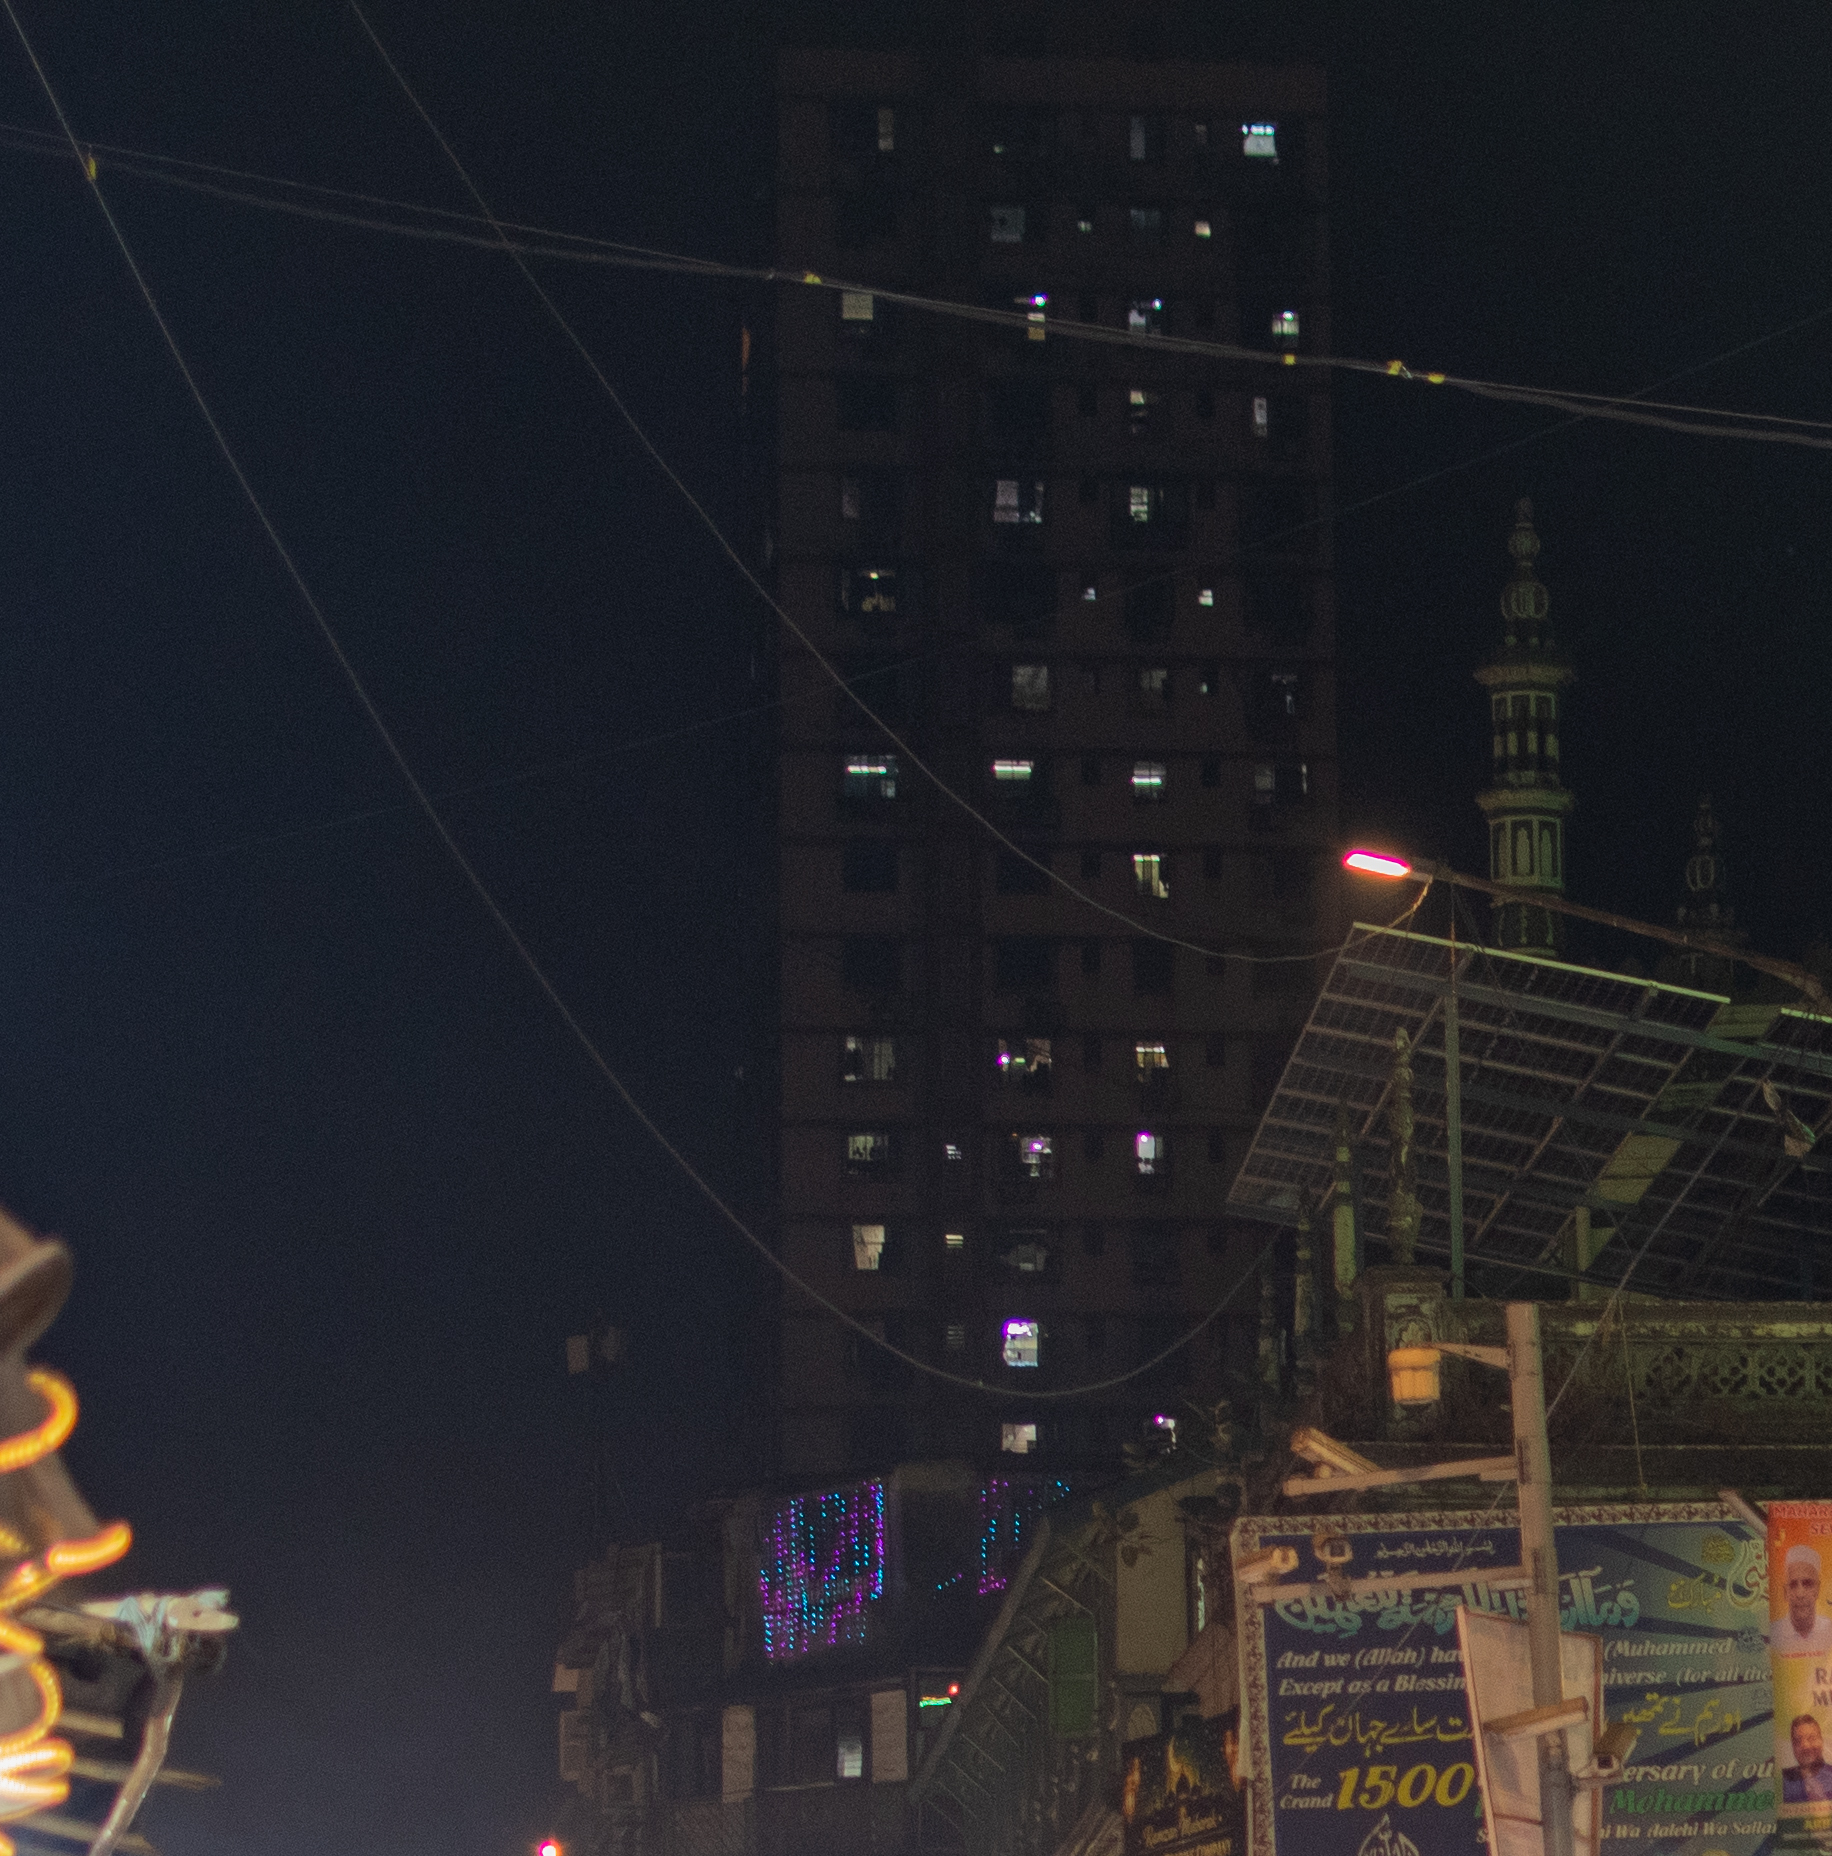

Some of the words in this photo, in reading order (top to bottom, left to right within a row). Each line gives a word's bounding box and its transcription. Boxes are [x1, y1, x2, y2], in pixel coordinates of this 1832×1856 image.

[1276, 1649, 1318, 1669] And
[1323, 1653, 1351, 1667] we
[1278, 1674, 1345, 1698] Except
[1348, 1677, 1372, 1692] as
[1375, 1677, 1390, 1692] a
[1711, 1758, 1740, 1780] of
[1290, 1774, 1323, 1790] The
[1337, 1762, 1475, 1811] 1500
[1279, 1794, 1335, 1810] Grand
[1703, 1820, 1729, 1836] Wa
